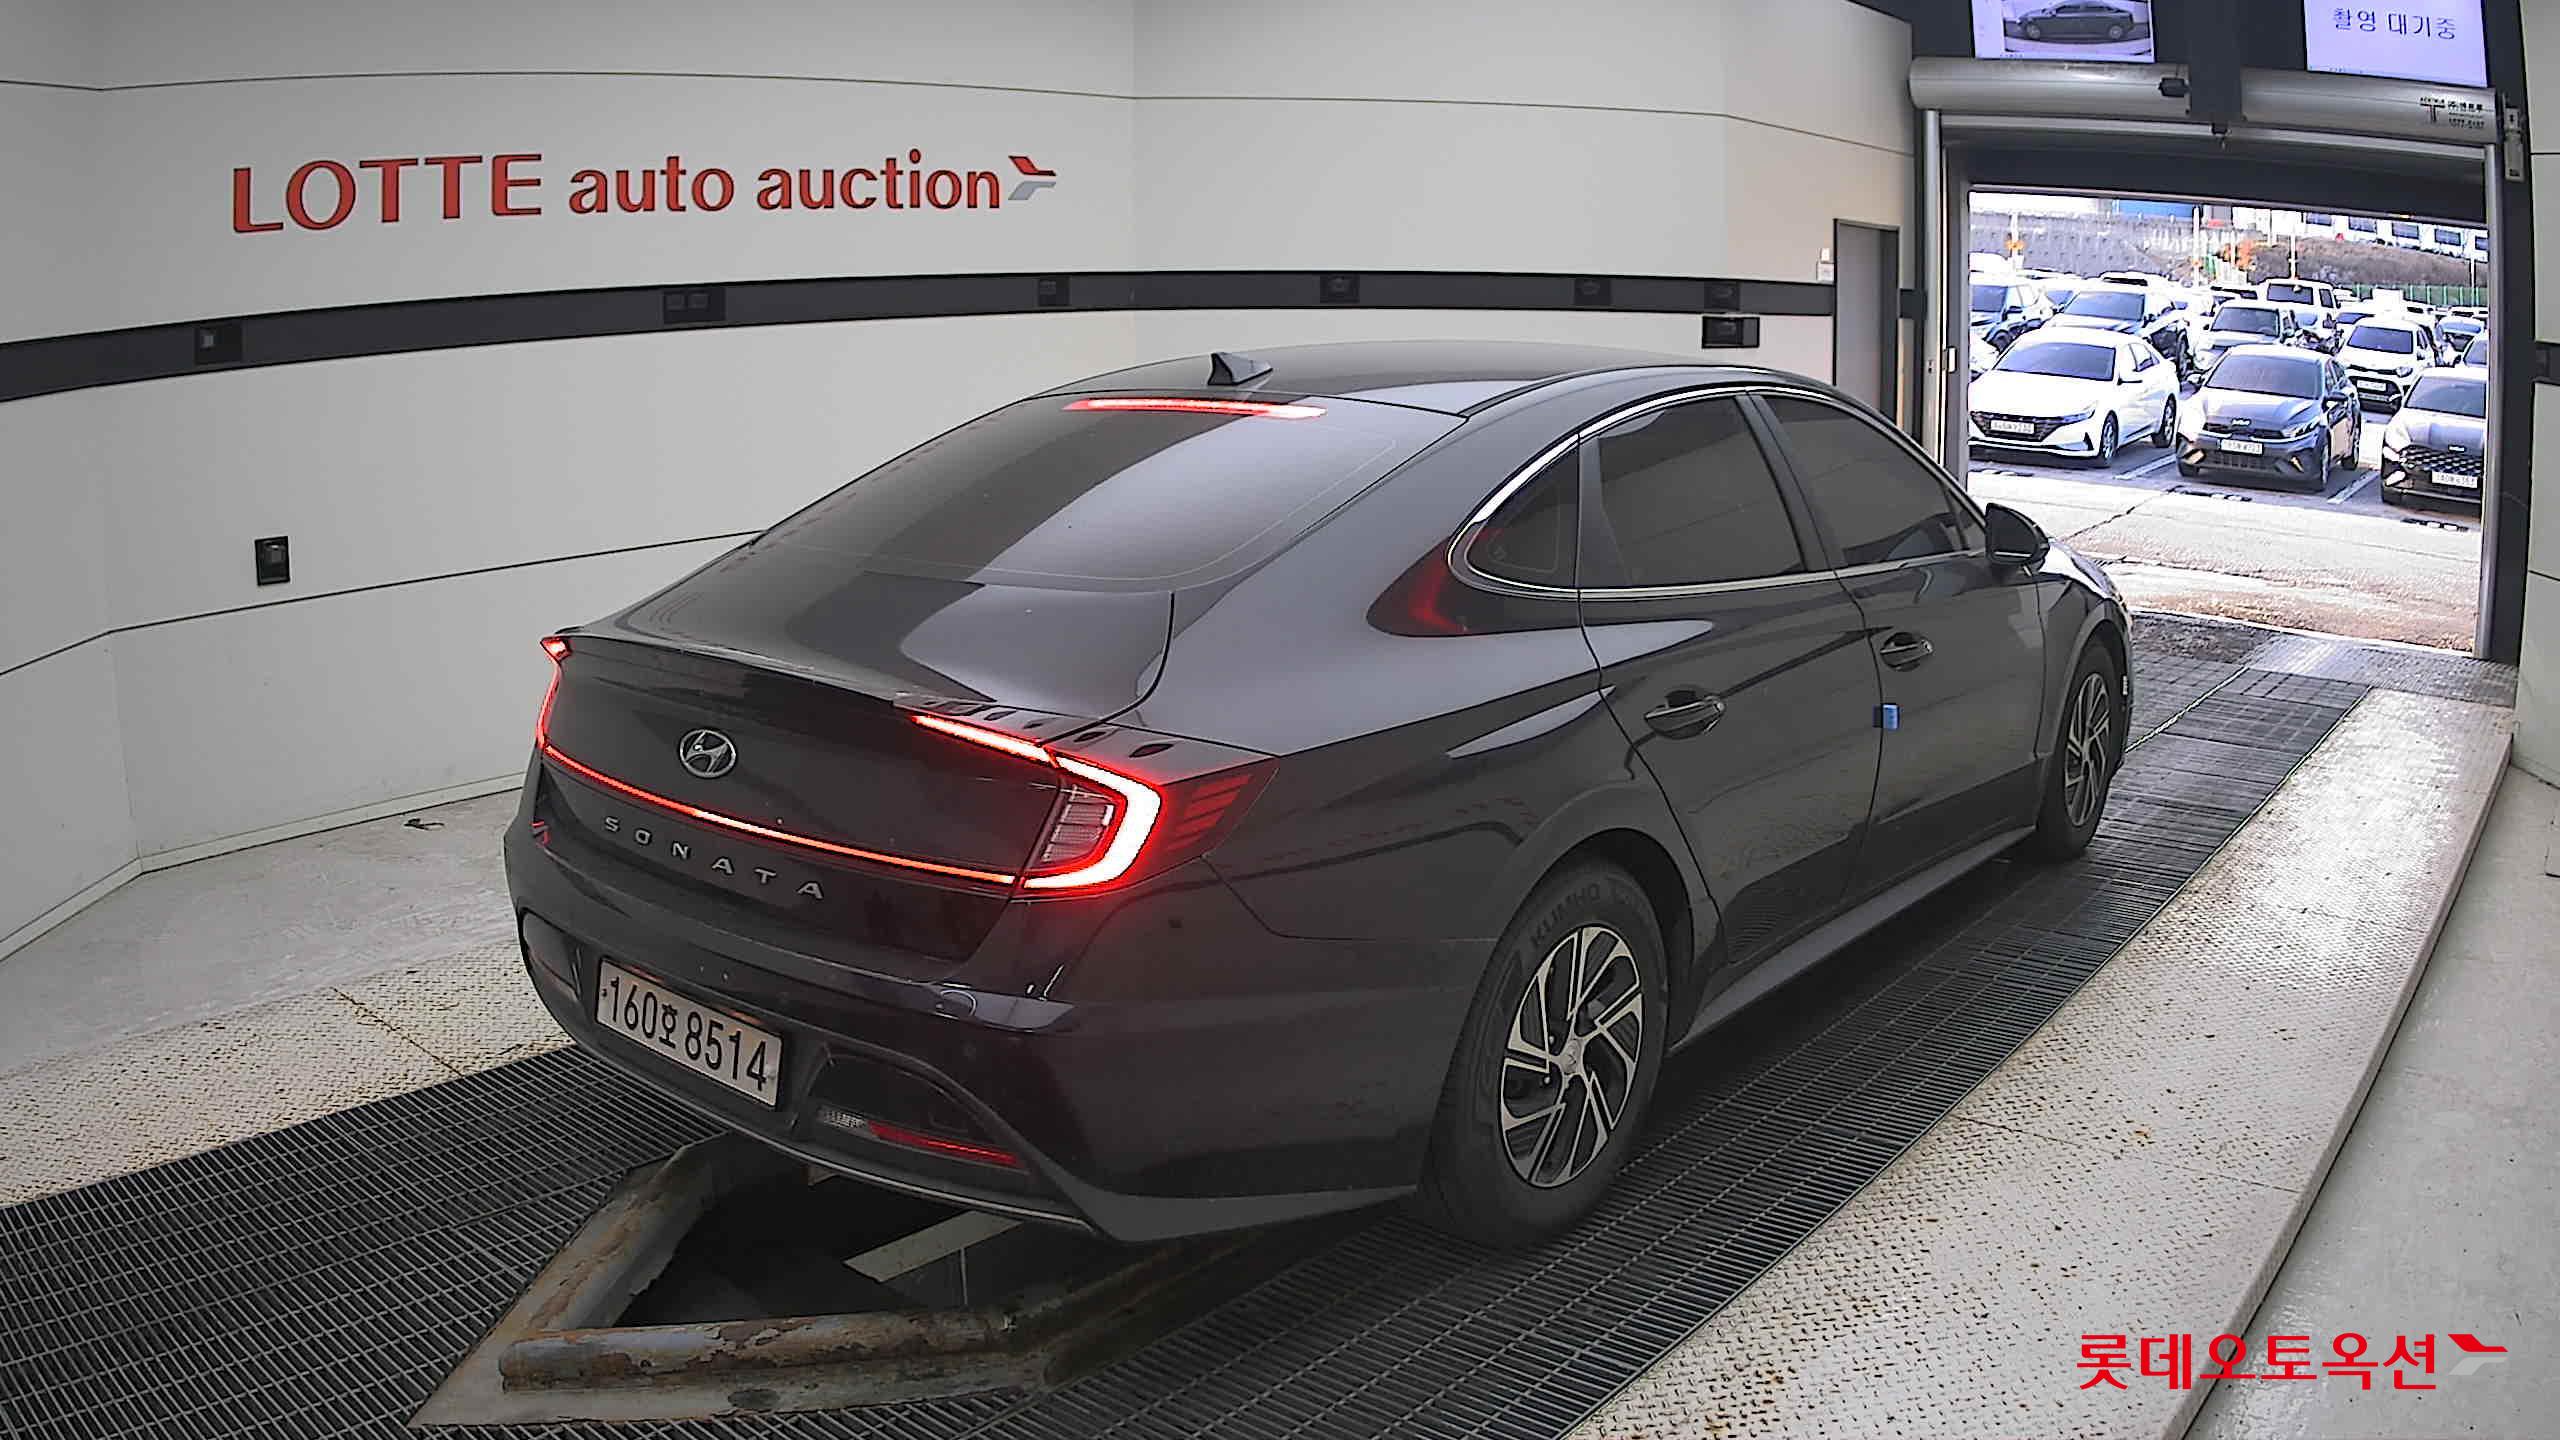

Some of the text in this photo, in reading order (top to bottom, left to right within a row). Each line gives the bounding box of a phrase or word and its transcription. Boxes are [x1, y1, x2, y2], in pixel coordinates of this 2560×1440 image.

[2388, 13, 2456, 40] 대기중
[233, 149, 1002, 233] LOTTE auto auction
[604, 816, 824, 900] SONATA
